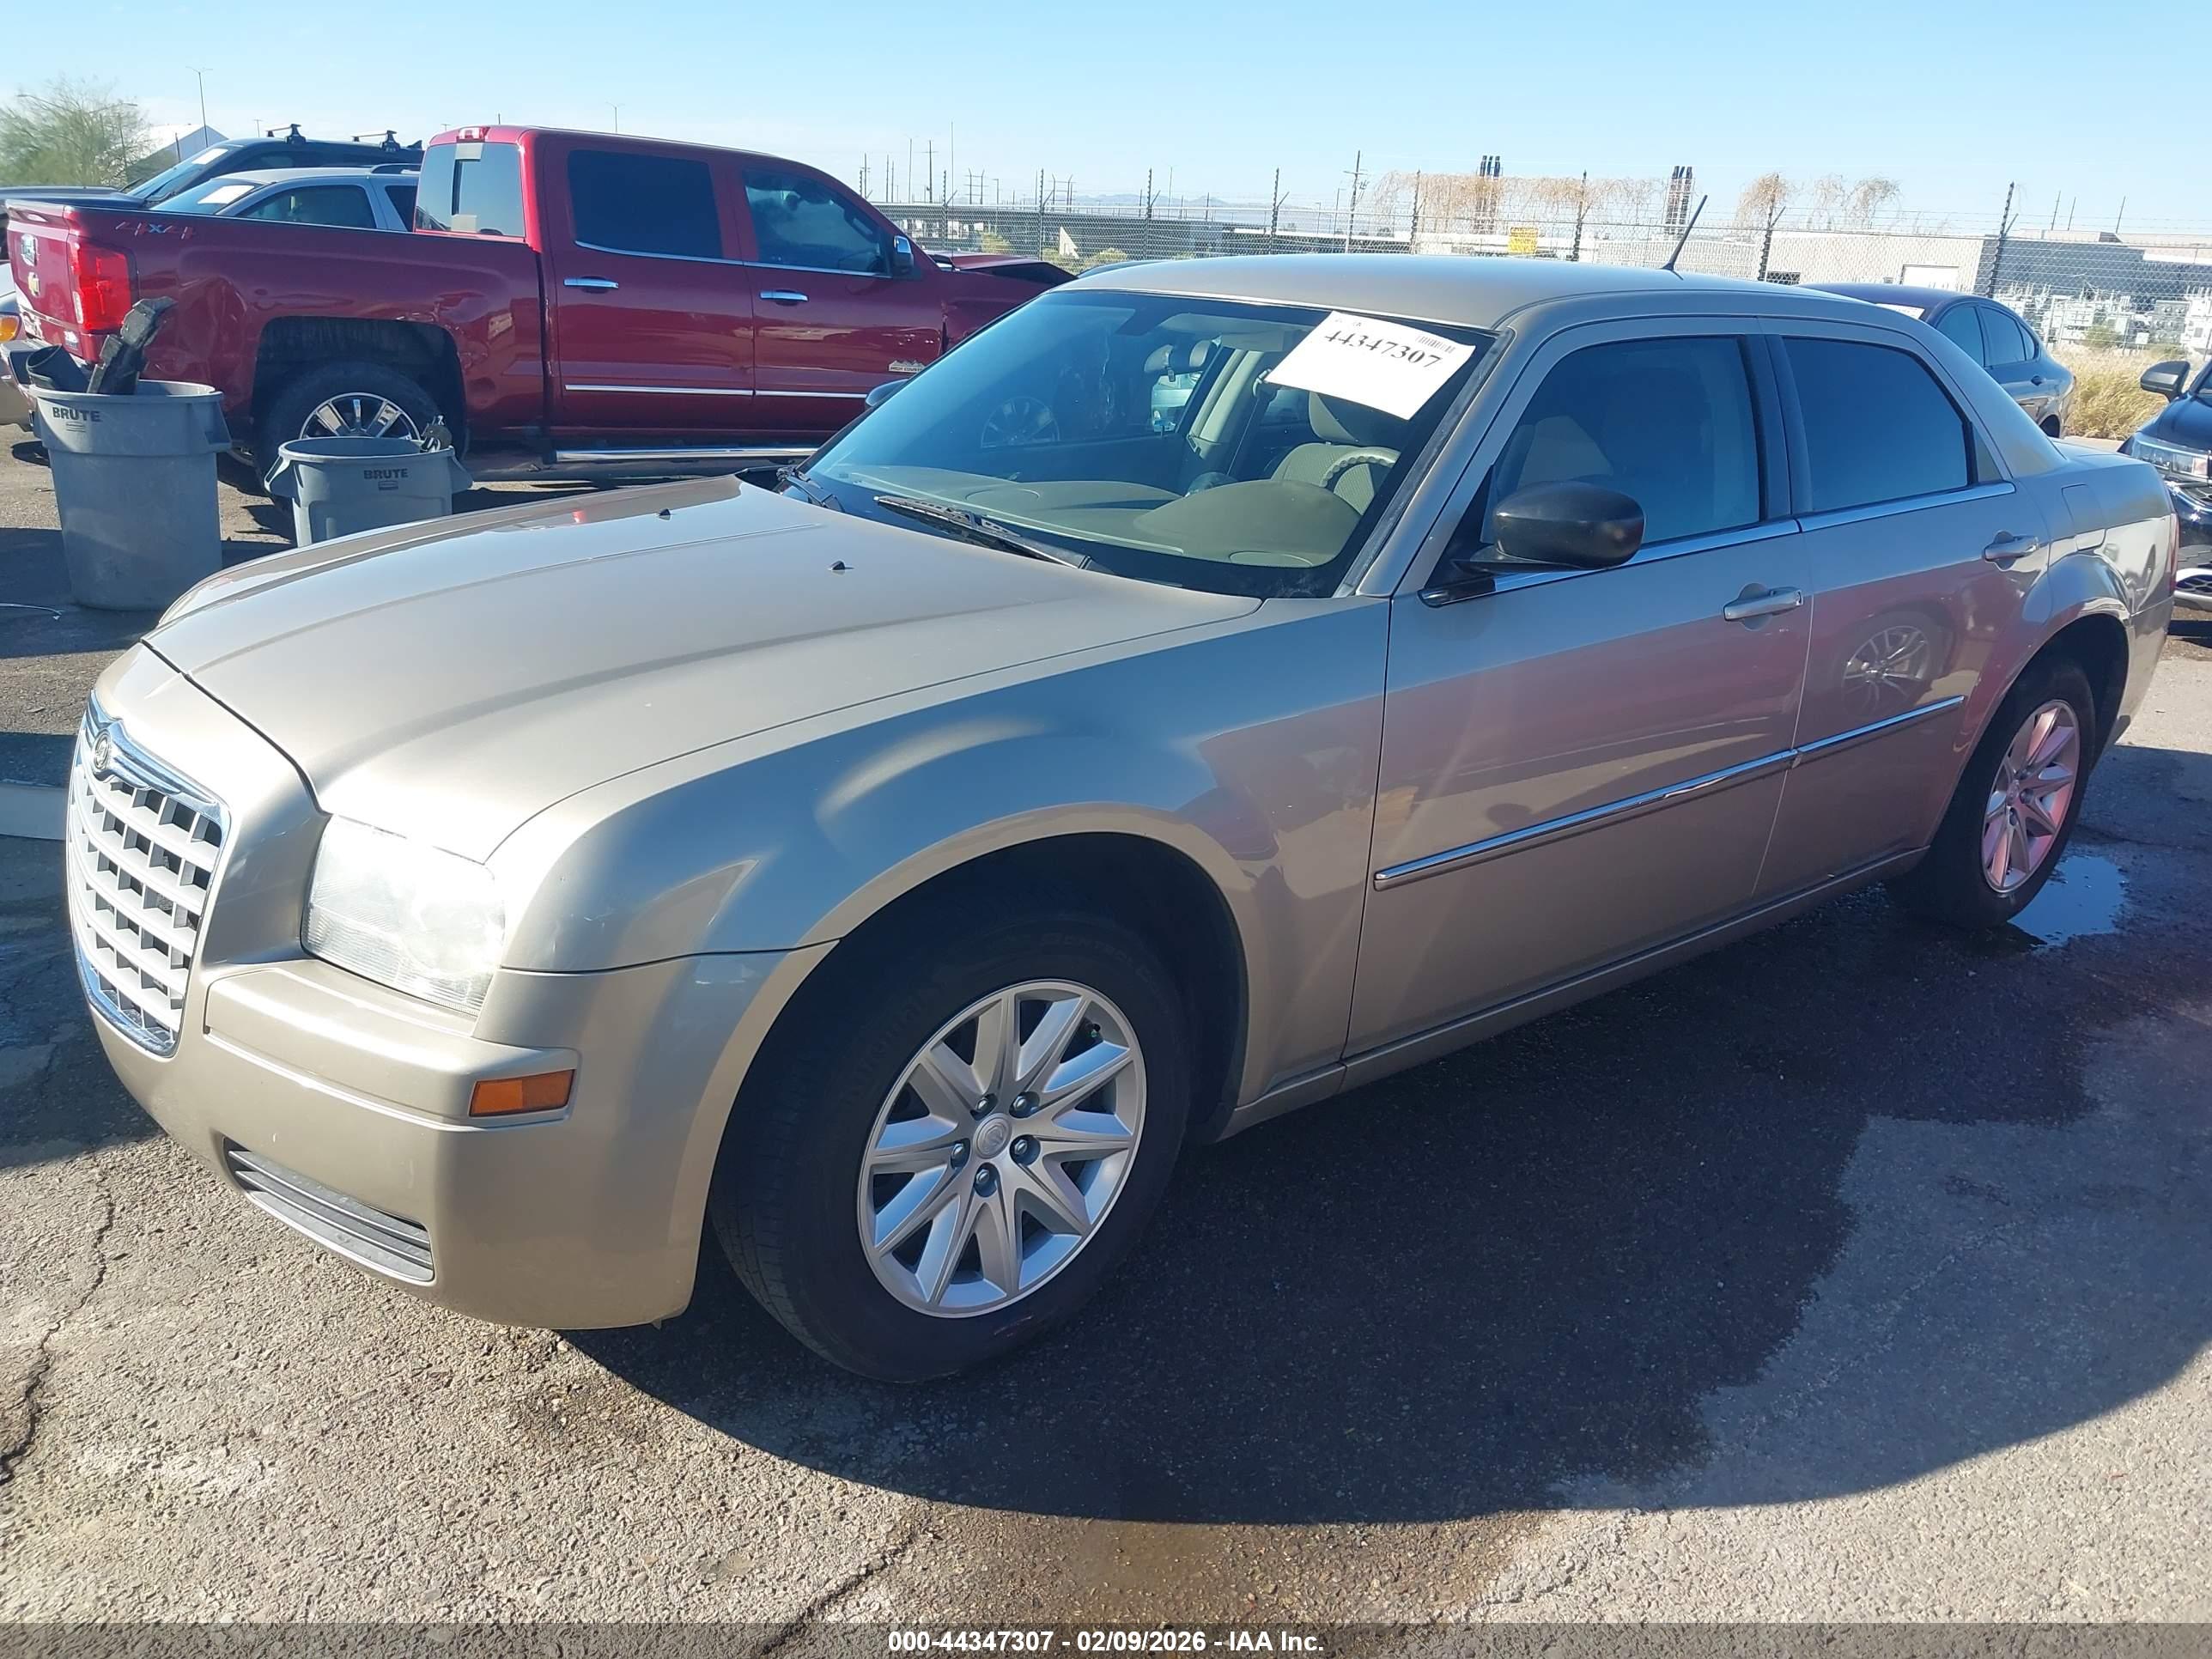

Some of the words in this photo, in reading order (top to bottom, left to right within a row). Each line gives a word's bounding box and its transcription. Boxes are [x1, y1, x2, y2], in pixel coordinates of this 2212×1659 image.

[1323, 330, 1443, 368] 44347307
[52, 407, 102, 422] BRUTE
[363, 468, 409, 479] BRUTE
